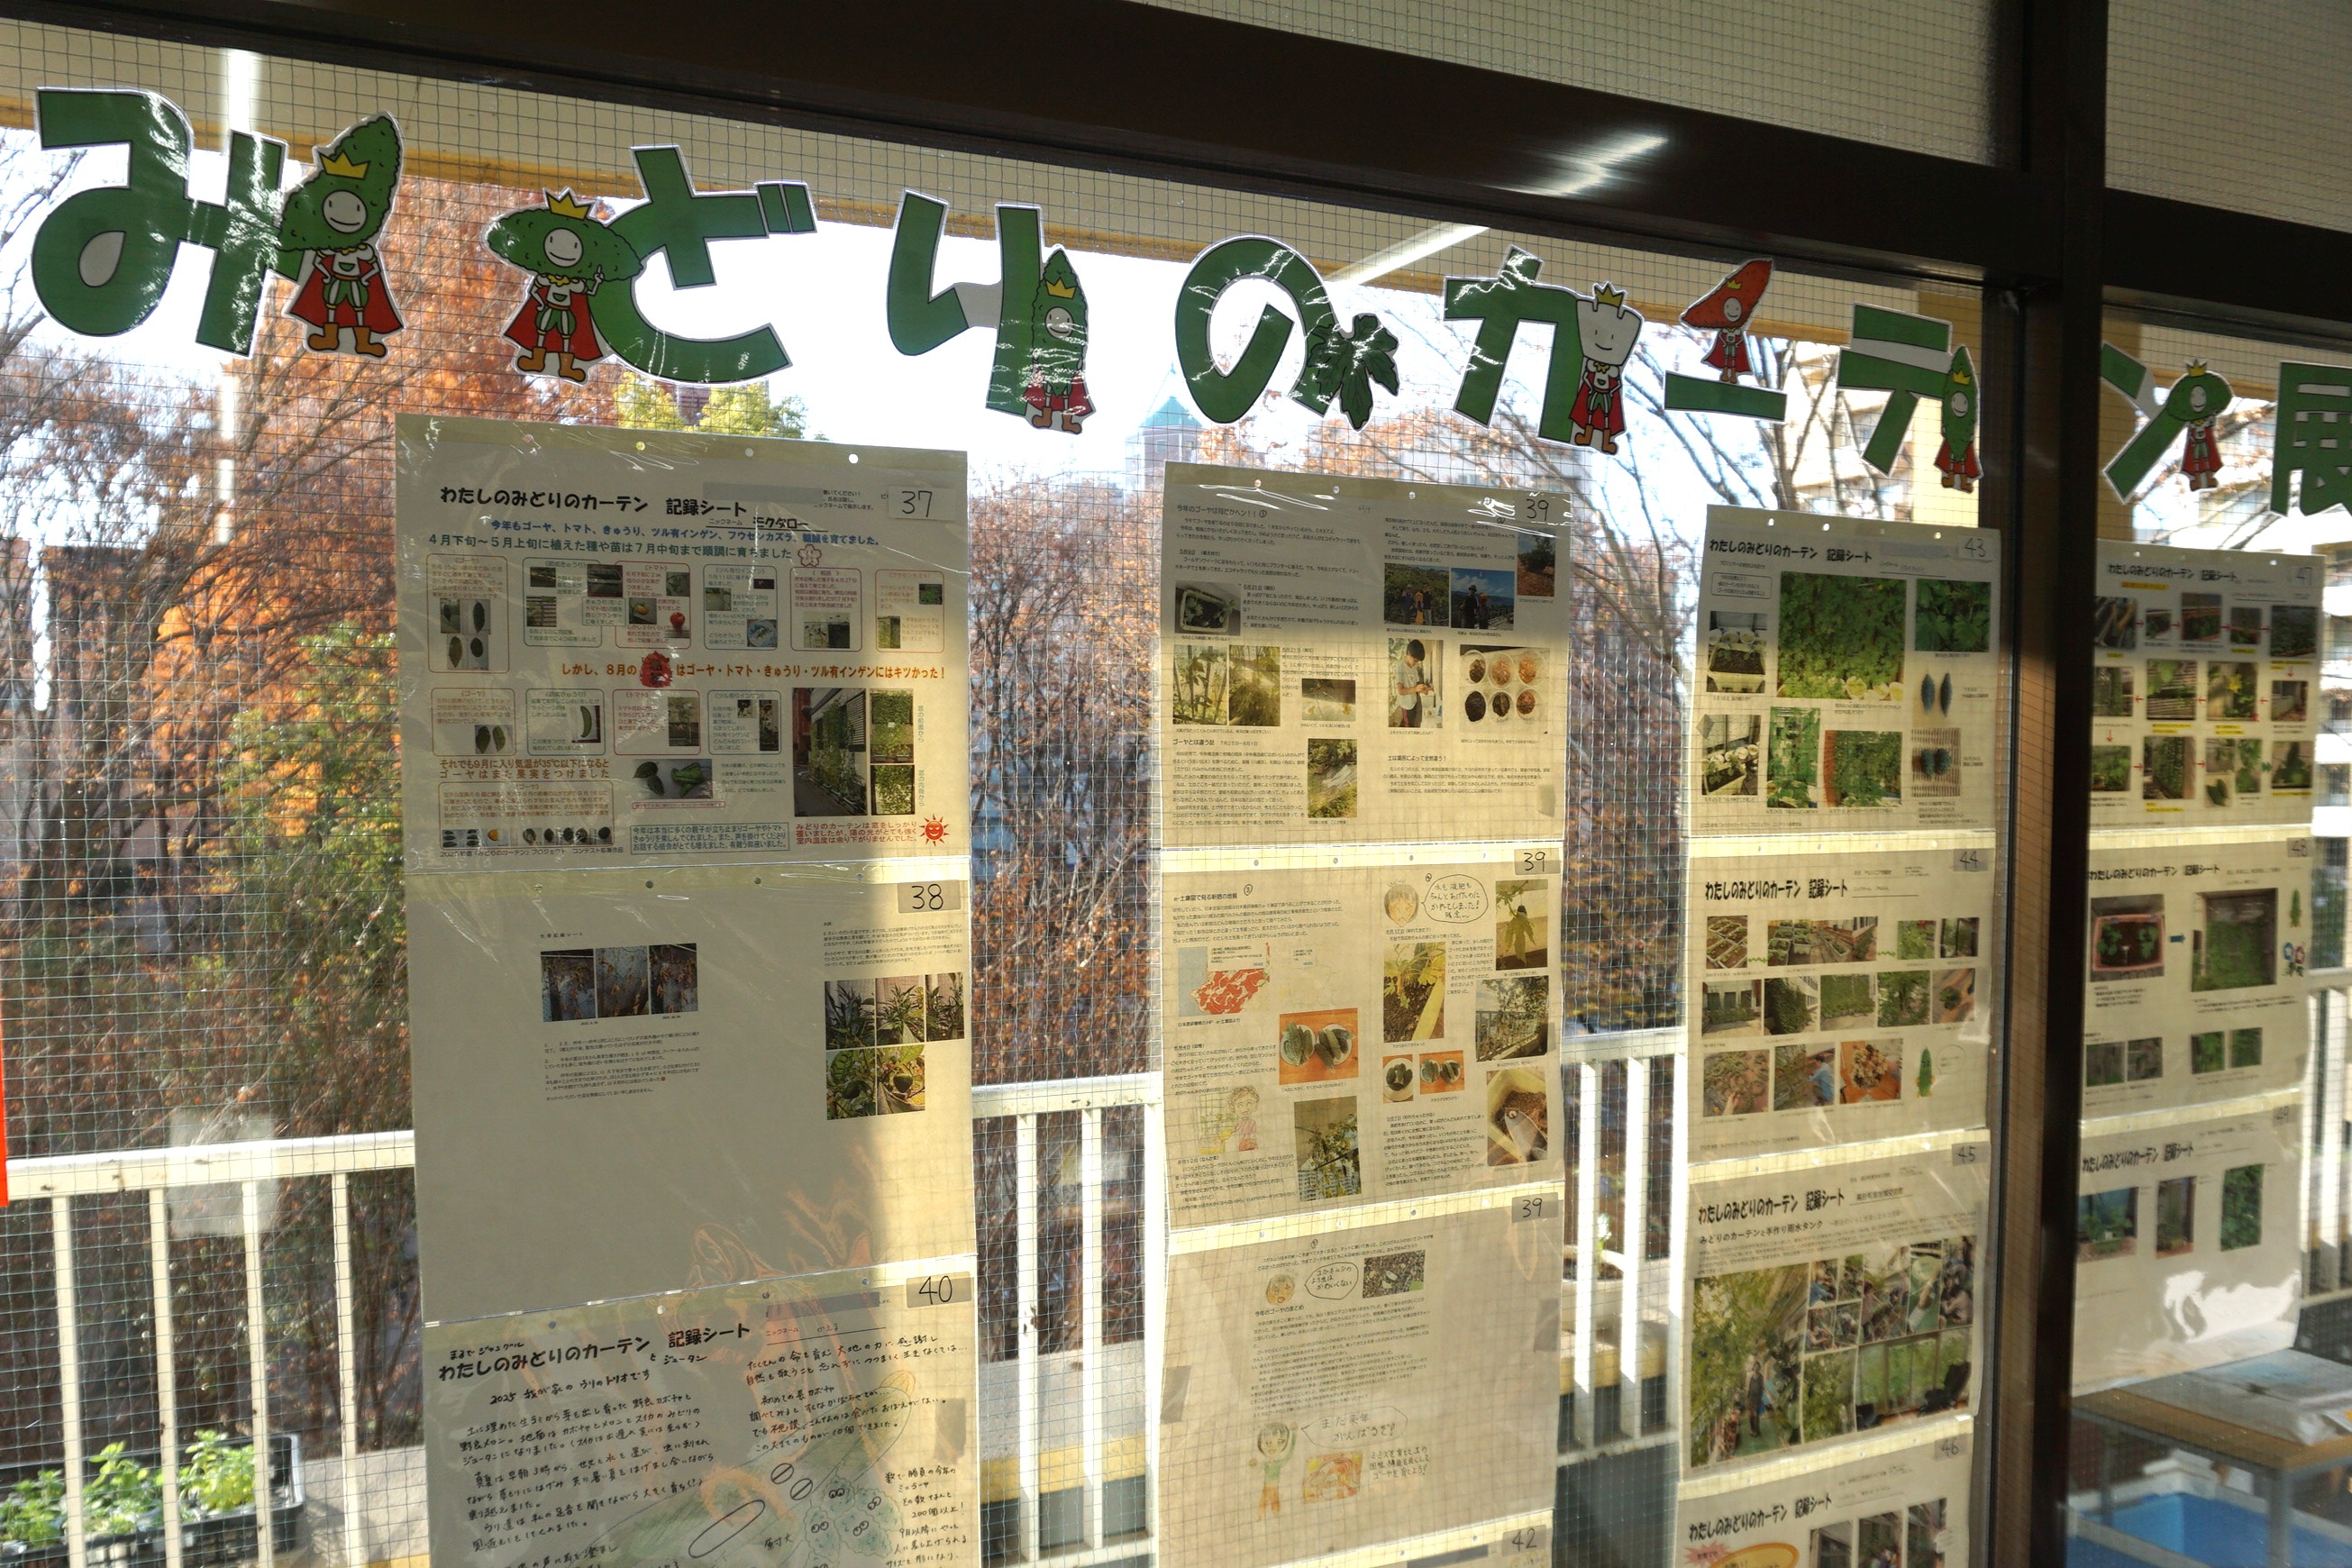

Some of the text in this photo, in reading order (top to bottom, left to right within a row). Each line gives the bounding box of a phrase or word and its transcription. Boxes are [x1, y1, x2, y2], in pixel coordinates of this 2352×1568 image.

[440, 487, 747, 517] わたしのみどりのカーテン 記録シート
[901, 489, 933, 518] 37
[1525, 498, 1550, 522] 39
[1709, 538, 1873, 563] わたしのみどりのカーテン 記録シート
[1965, 537, 1986, 559] 43
[2108, 564, 2238, 582] わたしのみどりのカーテン 記録シート
[561, 661, 637, 676] しかし、8月の
[676, 663, 944, 679] はゴーヤ・トマト・きゅうり・ツル有インゲンにはキツかった!
[439, 759, 610, 770] それでも9月に入り気温が35℃以下になると
[439, 769, 610, 779] ゴーヤはまた果実をつけました
[1523, 852, 1546, 872] 39
[1959, 851, 1979, 867] 44
[2087, 863, 2220, 881] わたしのみどりのカーテン 記録シート
[911, 882, 944, 910] 38
[1429, 891, 1481, 901] ちゃんとあげたのに
[1705, 878, 1848, 901] わたしのみどりのカーテン 記録シート
[1958, 1145, 1976, 1163] 45
[2083, 1142, 2194, 1175] わたしのみどりのカーテン 記録シート
[1521, 1199, 1544, 1218] 39
[1698, 1188, 1846, 1226] わたしのみどりのカーテン 記録シート
[1700, 1220, 1824, 1244] みどりのカーテンと手作り雨水タンク
[918, 1275, 953, 1305] 40
[765, 1326, 799, 1336] ニックネーム
[438, 1322, 751, 1381] わたしのみどりのカーテン 記録シート
[449, 1349, 476, 1361] まるで
[489, 1391, 517, 1405] 2025
[523, 1382, 573, 1399] 我が家の
[1321, 1413, 1370, 1429] また来年
[1940, 1440, 1960, 1456] 46
[1689, 1493, 1832, 1543] わたしのみどりのカーテン 記録シート
[1511, 1527, 1537, 1552] 42
